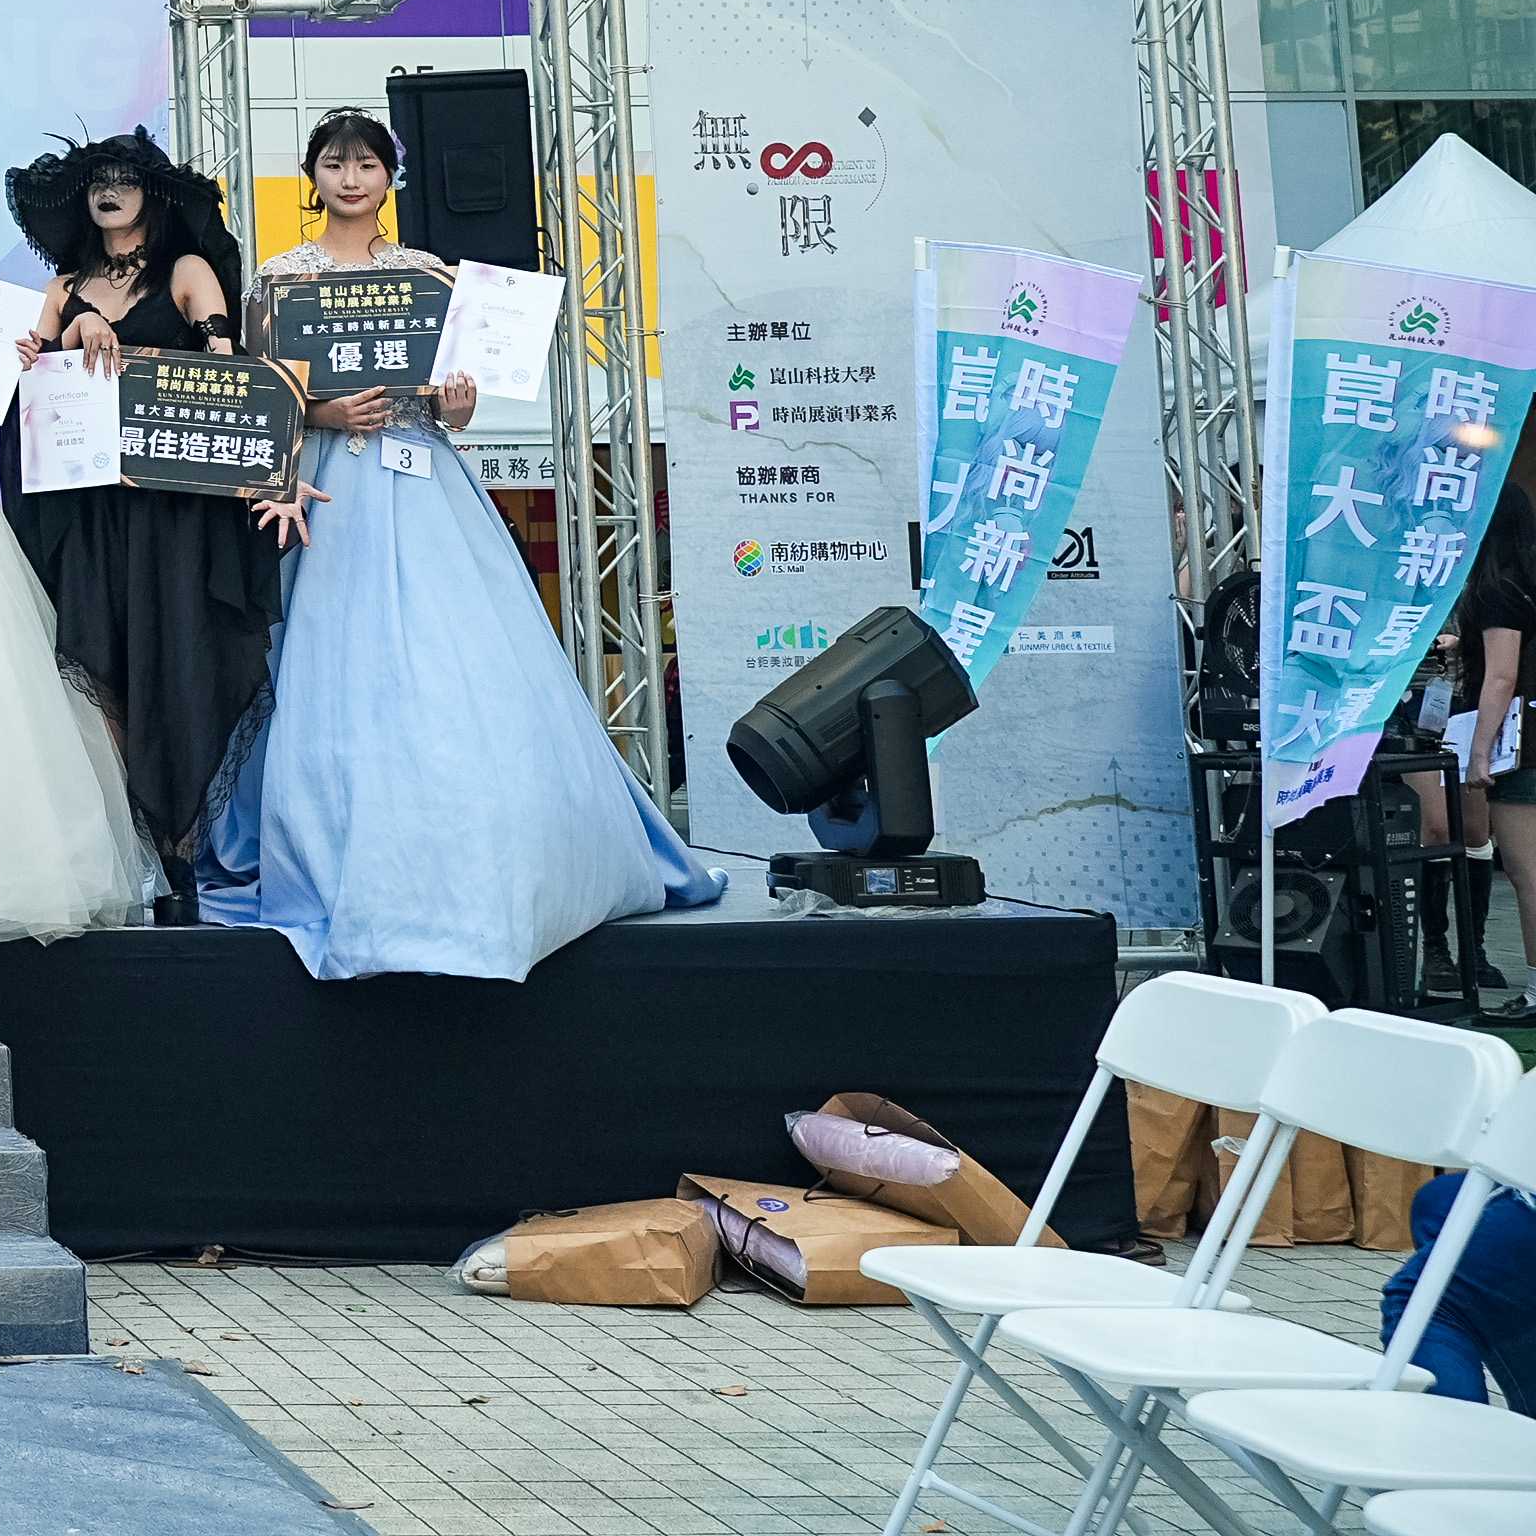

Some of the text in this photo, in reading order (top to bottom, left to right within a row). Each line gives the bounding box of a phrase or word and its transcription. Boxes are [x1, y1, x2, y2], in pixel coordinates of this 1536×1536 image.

[319, 283, 412, 298] 崑山科技大學
[320, 295, 413, 309] 時尚展演事業系
[302, 317, 437, 336] 崑大盃時尚新星大賽
[727, 321, 812, 342] 主辦單位
[328, 339, 409, 373] 優選
[157, 364, 250, 384] 崑山科技大學
[770, 366, 876, 385] 崑山科技大學
[156, 378, 249, 397] 時尚展演事業系
[134, 403, 268, 427] 崑大盃時尚新星大賽
[772, 404, 897, 424] 時尚展演事業系
[120, 428, 275, 469] 最佳造型獎
[399, 448, 412, 469] 3
[736, 465, 820, 486] 協辦廠商
[740, 492, 835, 504] THANKS FOR
[770, 540, 888, 562] 南紡購物中心
[771, 565, 805, 574] T.S. Mall
